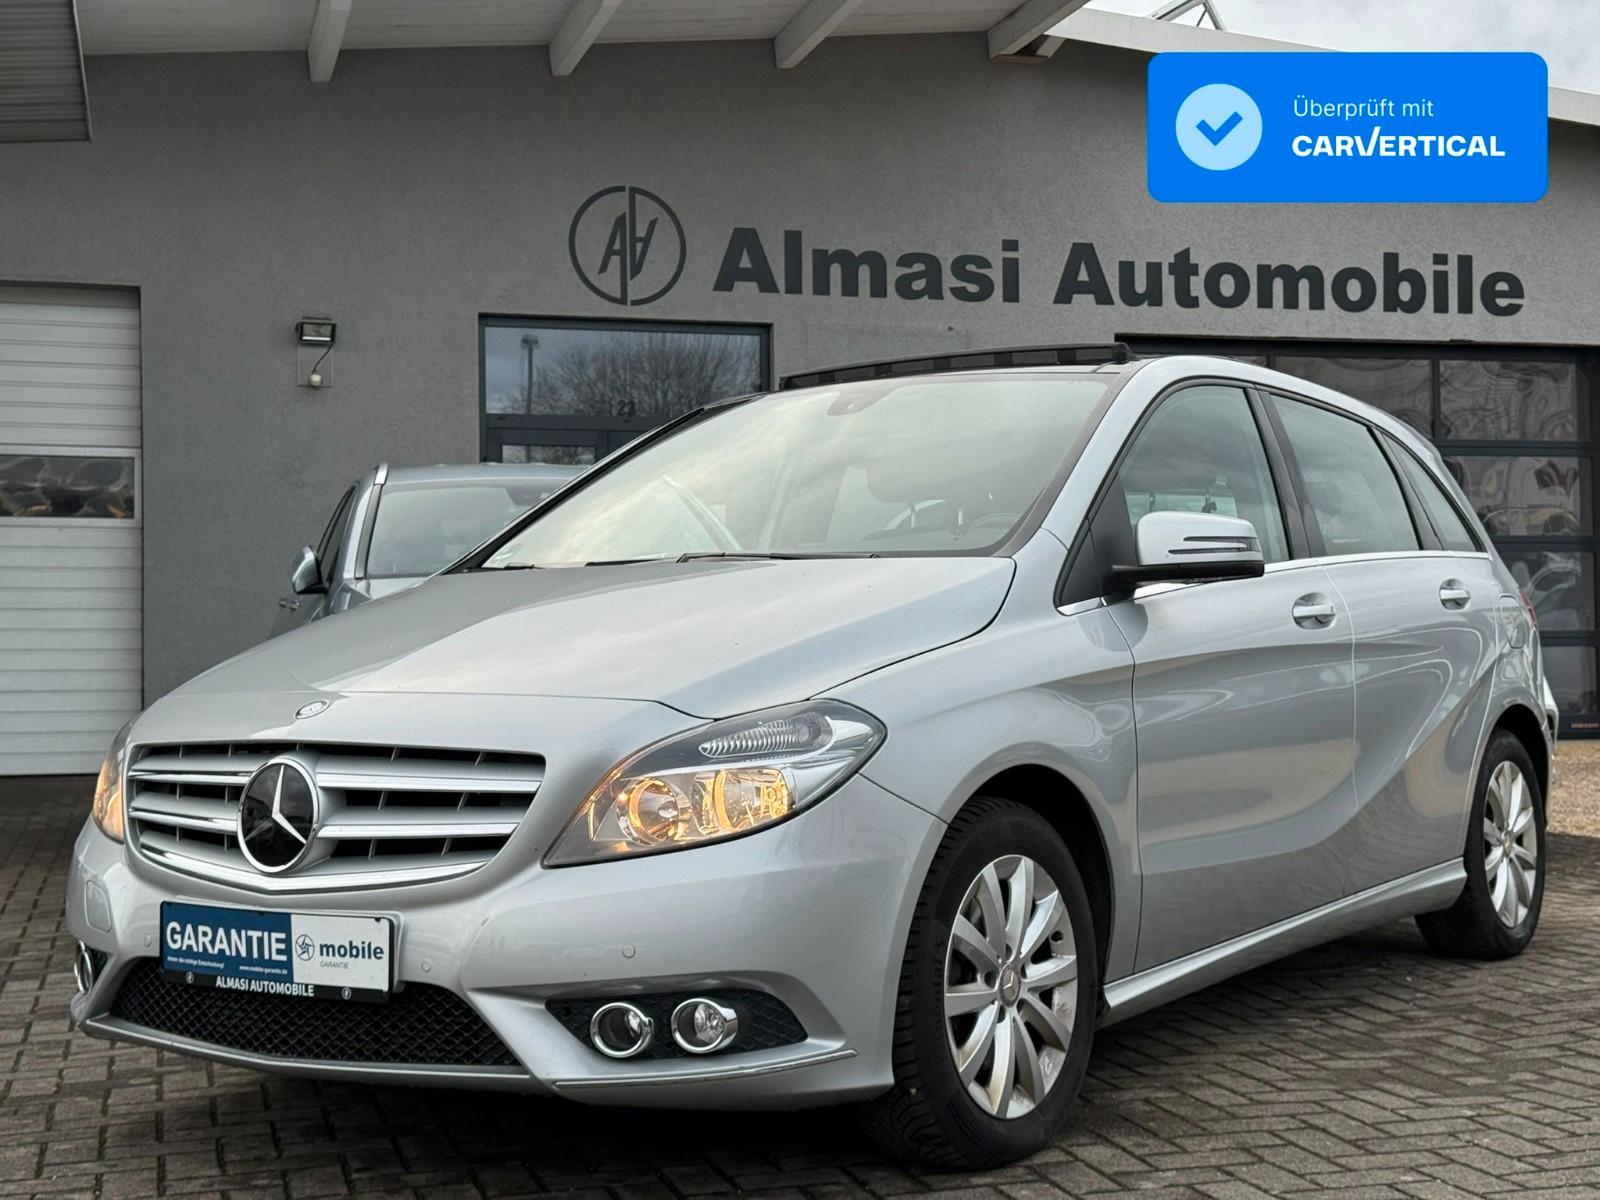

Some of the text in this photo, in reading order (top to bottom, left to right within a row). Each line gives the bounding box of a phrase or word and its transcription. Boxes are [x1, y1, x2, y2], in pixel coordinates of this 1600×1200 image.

[712, 227, 1525, 317] Almasi Automobile
[166, 921, 288, 962] GARANTIE
[319, 940, 384, 960] mobile
[215, 976, 315, 997] ALMASI AUTOMOBILE
